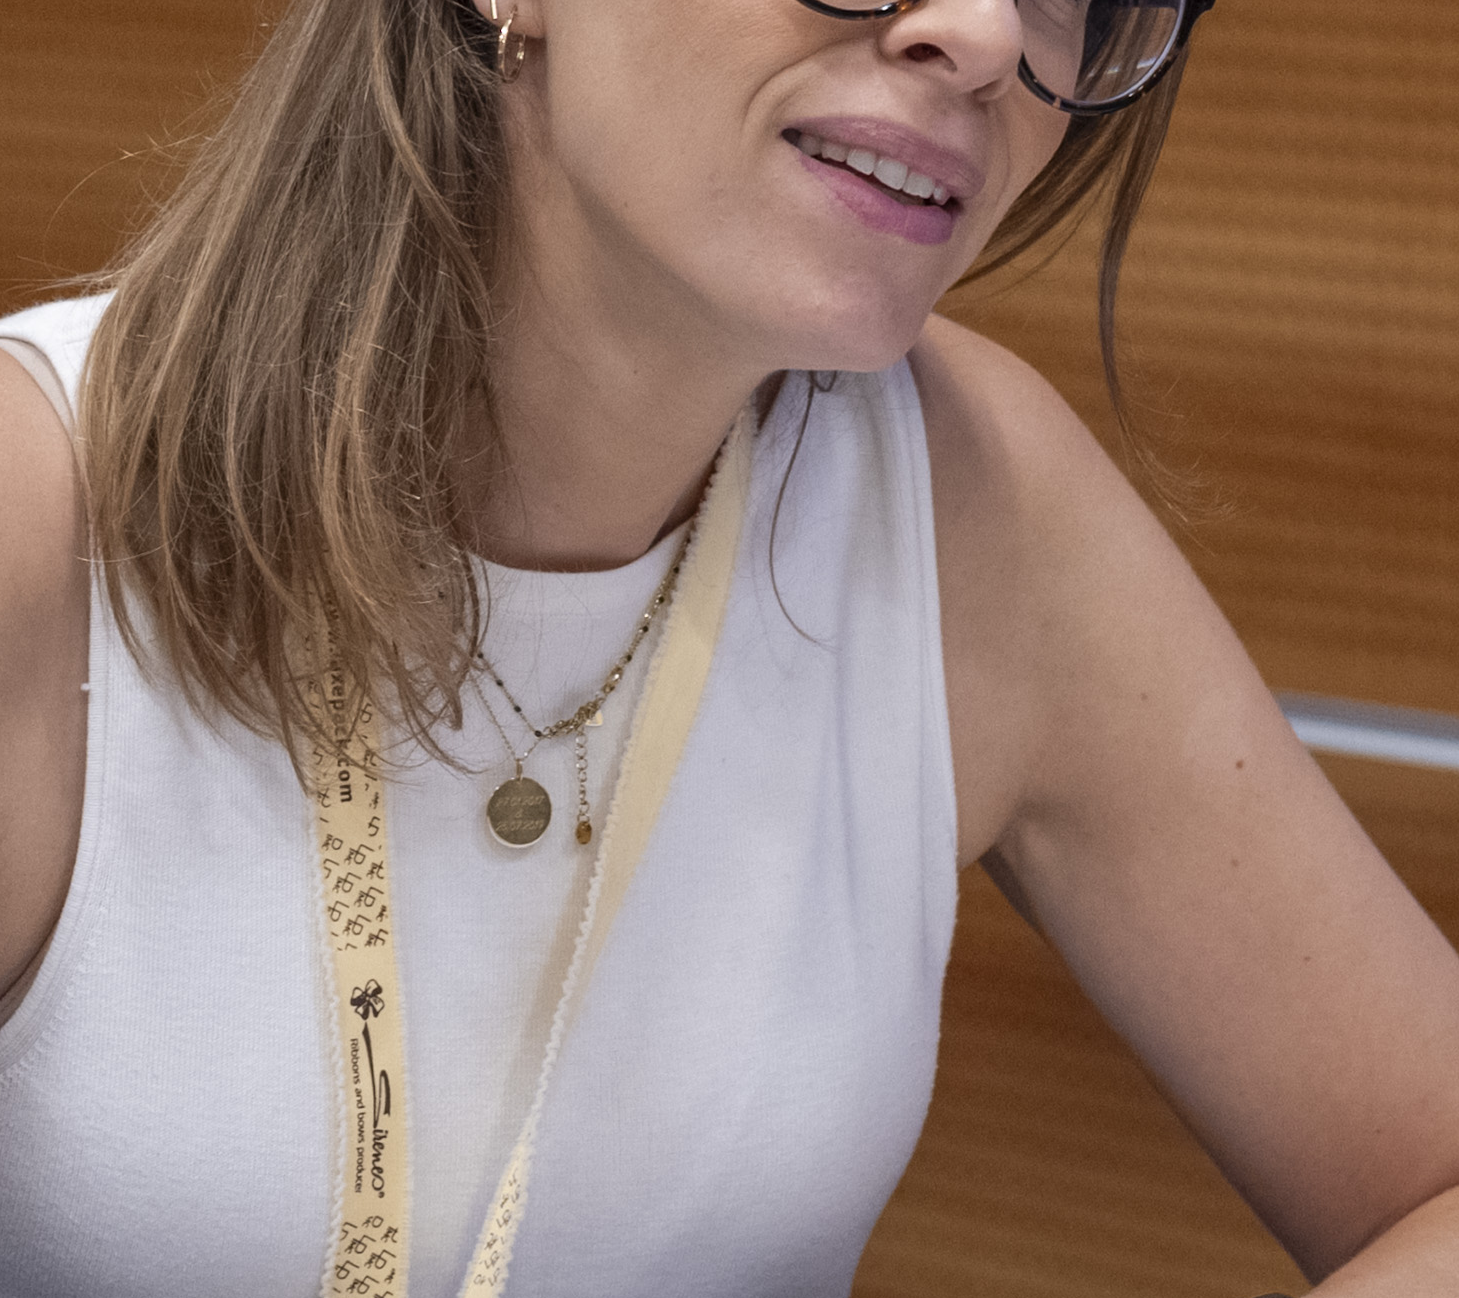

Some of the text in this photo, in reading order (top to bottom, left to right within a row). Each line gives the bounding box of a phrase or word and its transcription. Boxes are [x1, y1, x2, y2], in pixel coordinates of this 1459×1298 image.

[350, 1038, 366, 1193] Ribbons and bows producer
